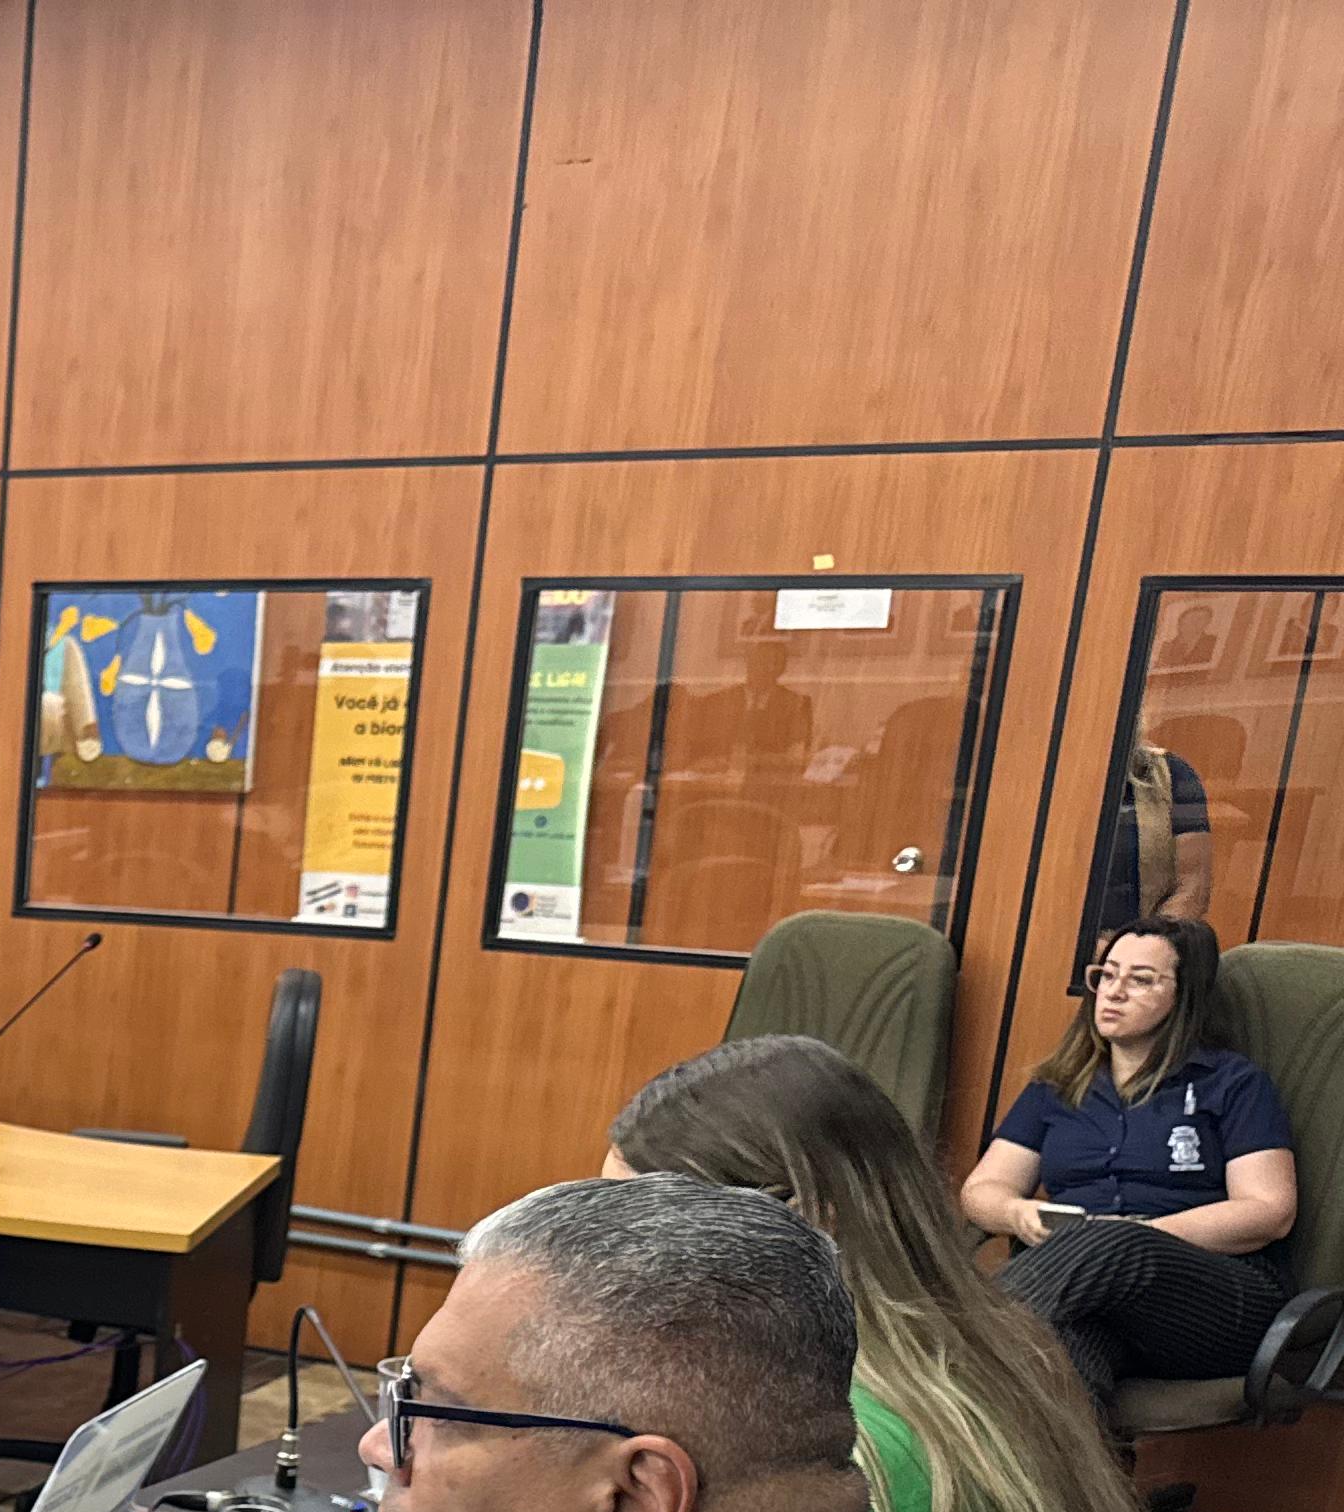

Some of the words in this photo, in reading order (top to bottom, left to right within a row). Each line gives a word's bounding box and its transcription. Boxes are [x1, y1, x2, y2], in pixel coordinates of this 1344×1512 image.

[335, 695, 378, 711] Você
[381, 695, 399, 713] já
[354, 723, 366, 735] a
